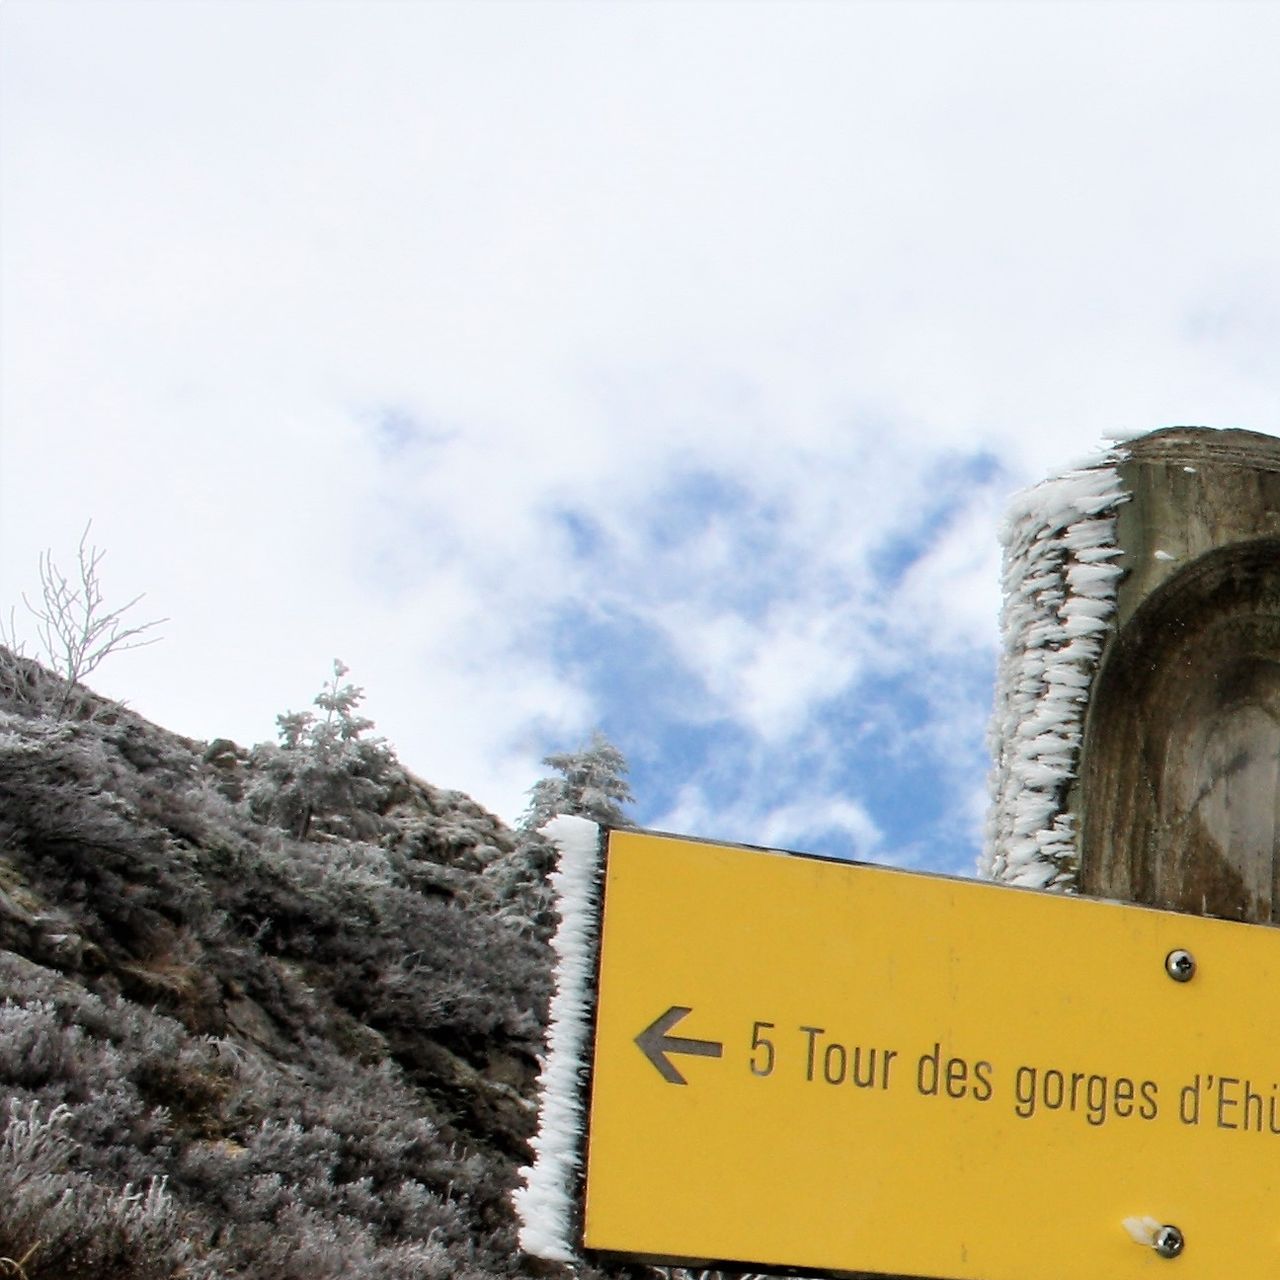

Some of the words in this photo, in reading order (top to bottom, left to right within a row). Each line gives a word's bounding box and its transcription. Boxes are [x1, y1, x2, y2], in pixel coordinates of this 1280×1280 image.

[748, 1020, 777, 1078] 5
[799, 1025, 898, 1091] Tour
[916, 1042, 994, 1103] des
[1014, 1065, 1159, 1127] gorges
